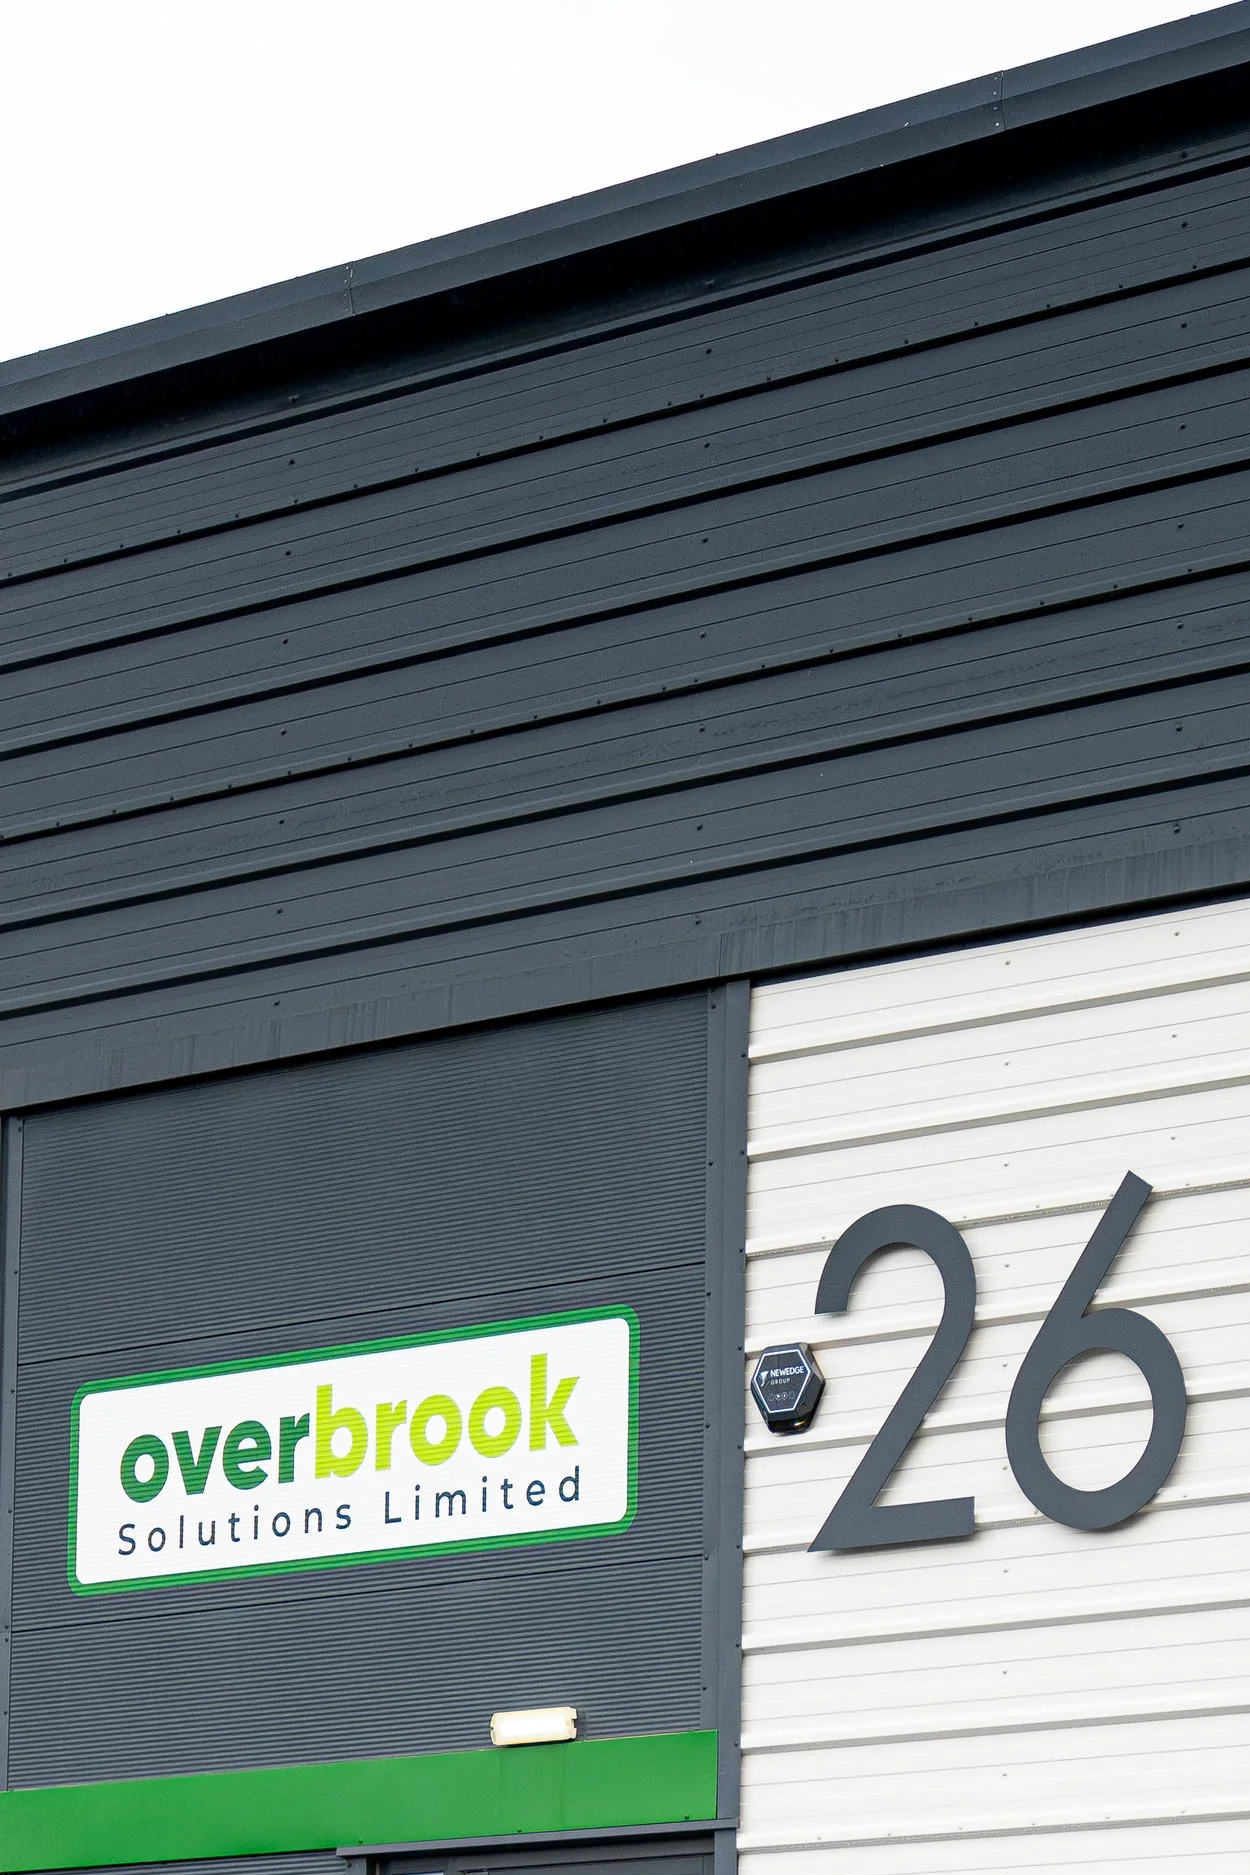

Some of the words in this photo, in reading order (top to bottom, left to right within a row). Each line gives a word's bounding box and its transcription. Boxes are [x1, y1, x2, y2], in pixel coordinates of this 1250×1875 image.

[770, 1365, 805, 1378] NEWEDGE
[807, 1170, 1188, 1553] 26
[119, 1352, 581, 1504] overbrook
[118, 1503, 352, 1556] Solutions
[383, 1465, 581, 1525] Limited
